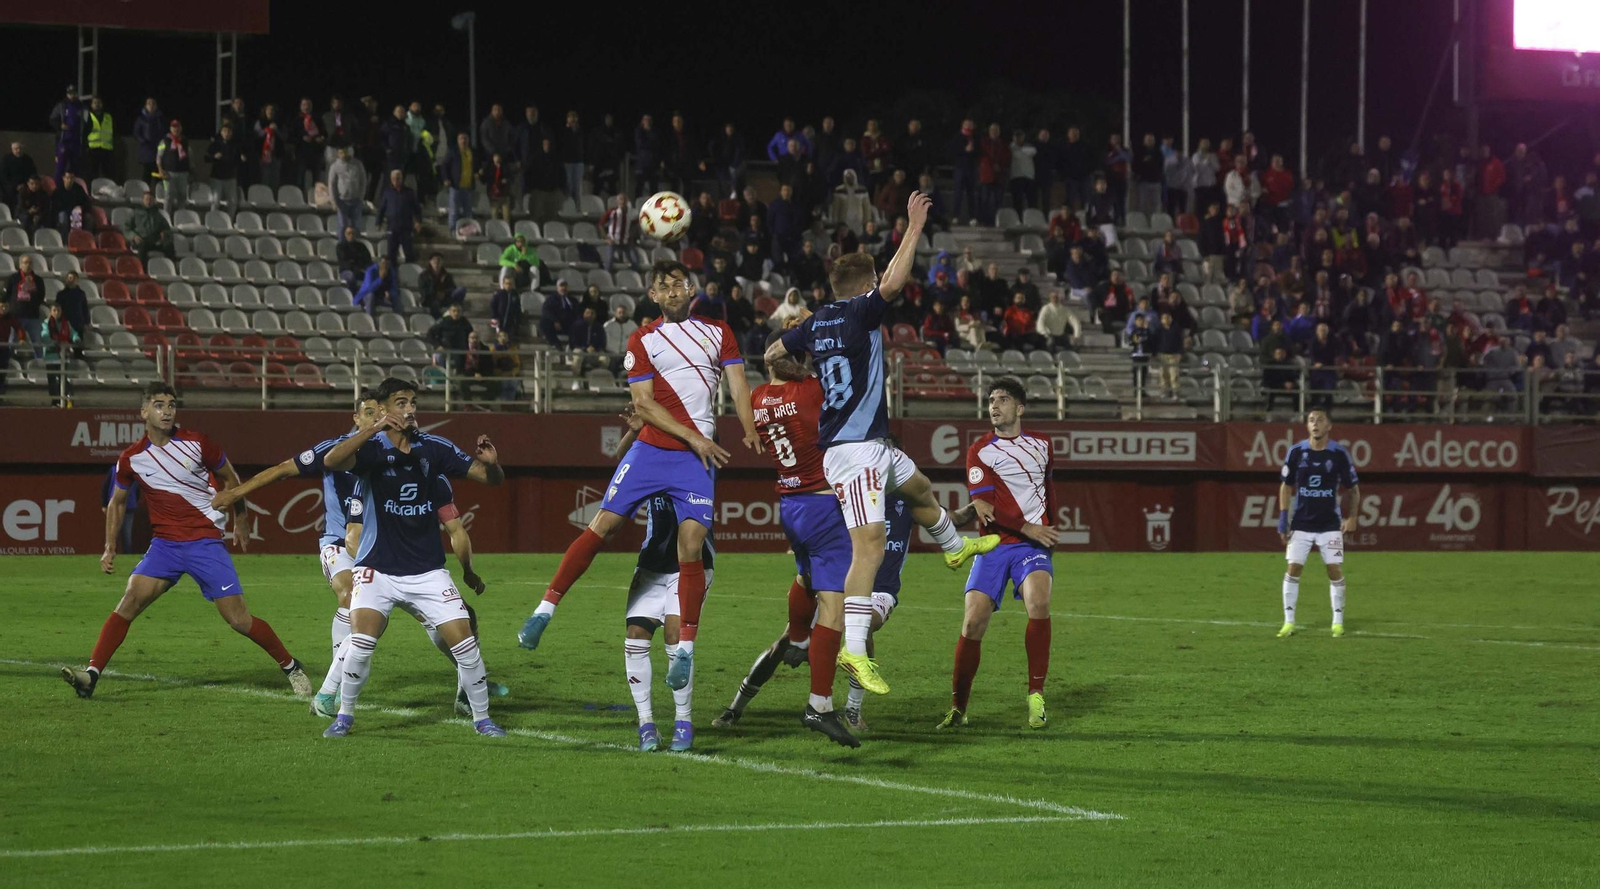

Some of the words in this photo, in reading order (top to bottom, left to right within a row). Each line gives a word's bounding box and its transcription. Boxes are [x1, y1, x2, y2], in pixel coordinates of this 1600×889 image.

[71, 421, 149, 447] A.MAR
[766, 423, 797, 468] 6
[1052, 436, 1191, 455] OGRUAS
[1394, 431, 1519, 468] Adecco
[614, 463, 631, 484] 8
[2, 499, 76, 541] er
[384, 499, 433, 517] fibranet
[1358, 496, 1417, 527] S.L.
[1425, 484, 1481, 531] 40
[41, 546, 48, 555] Y
[48, 546, 76, 555] VENTA
